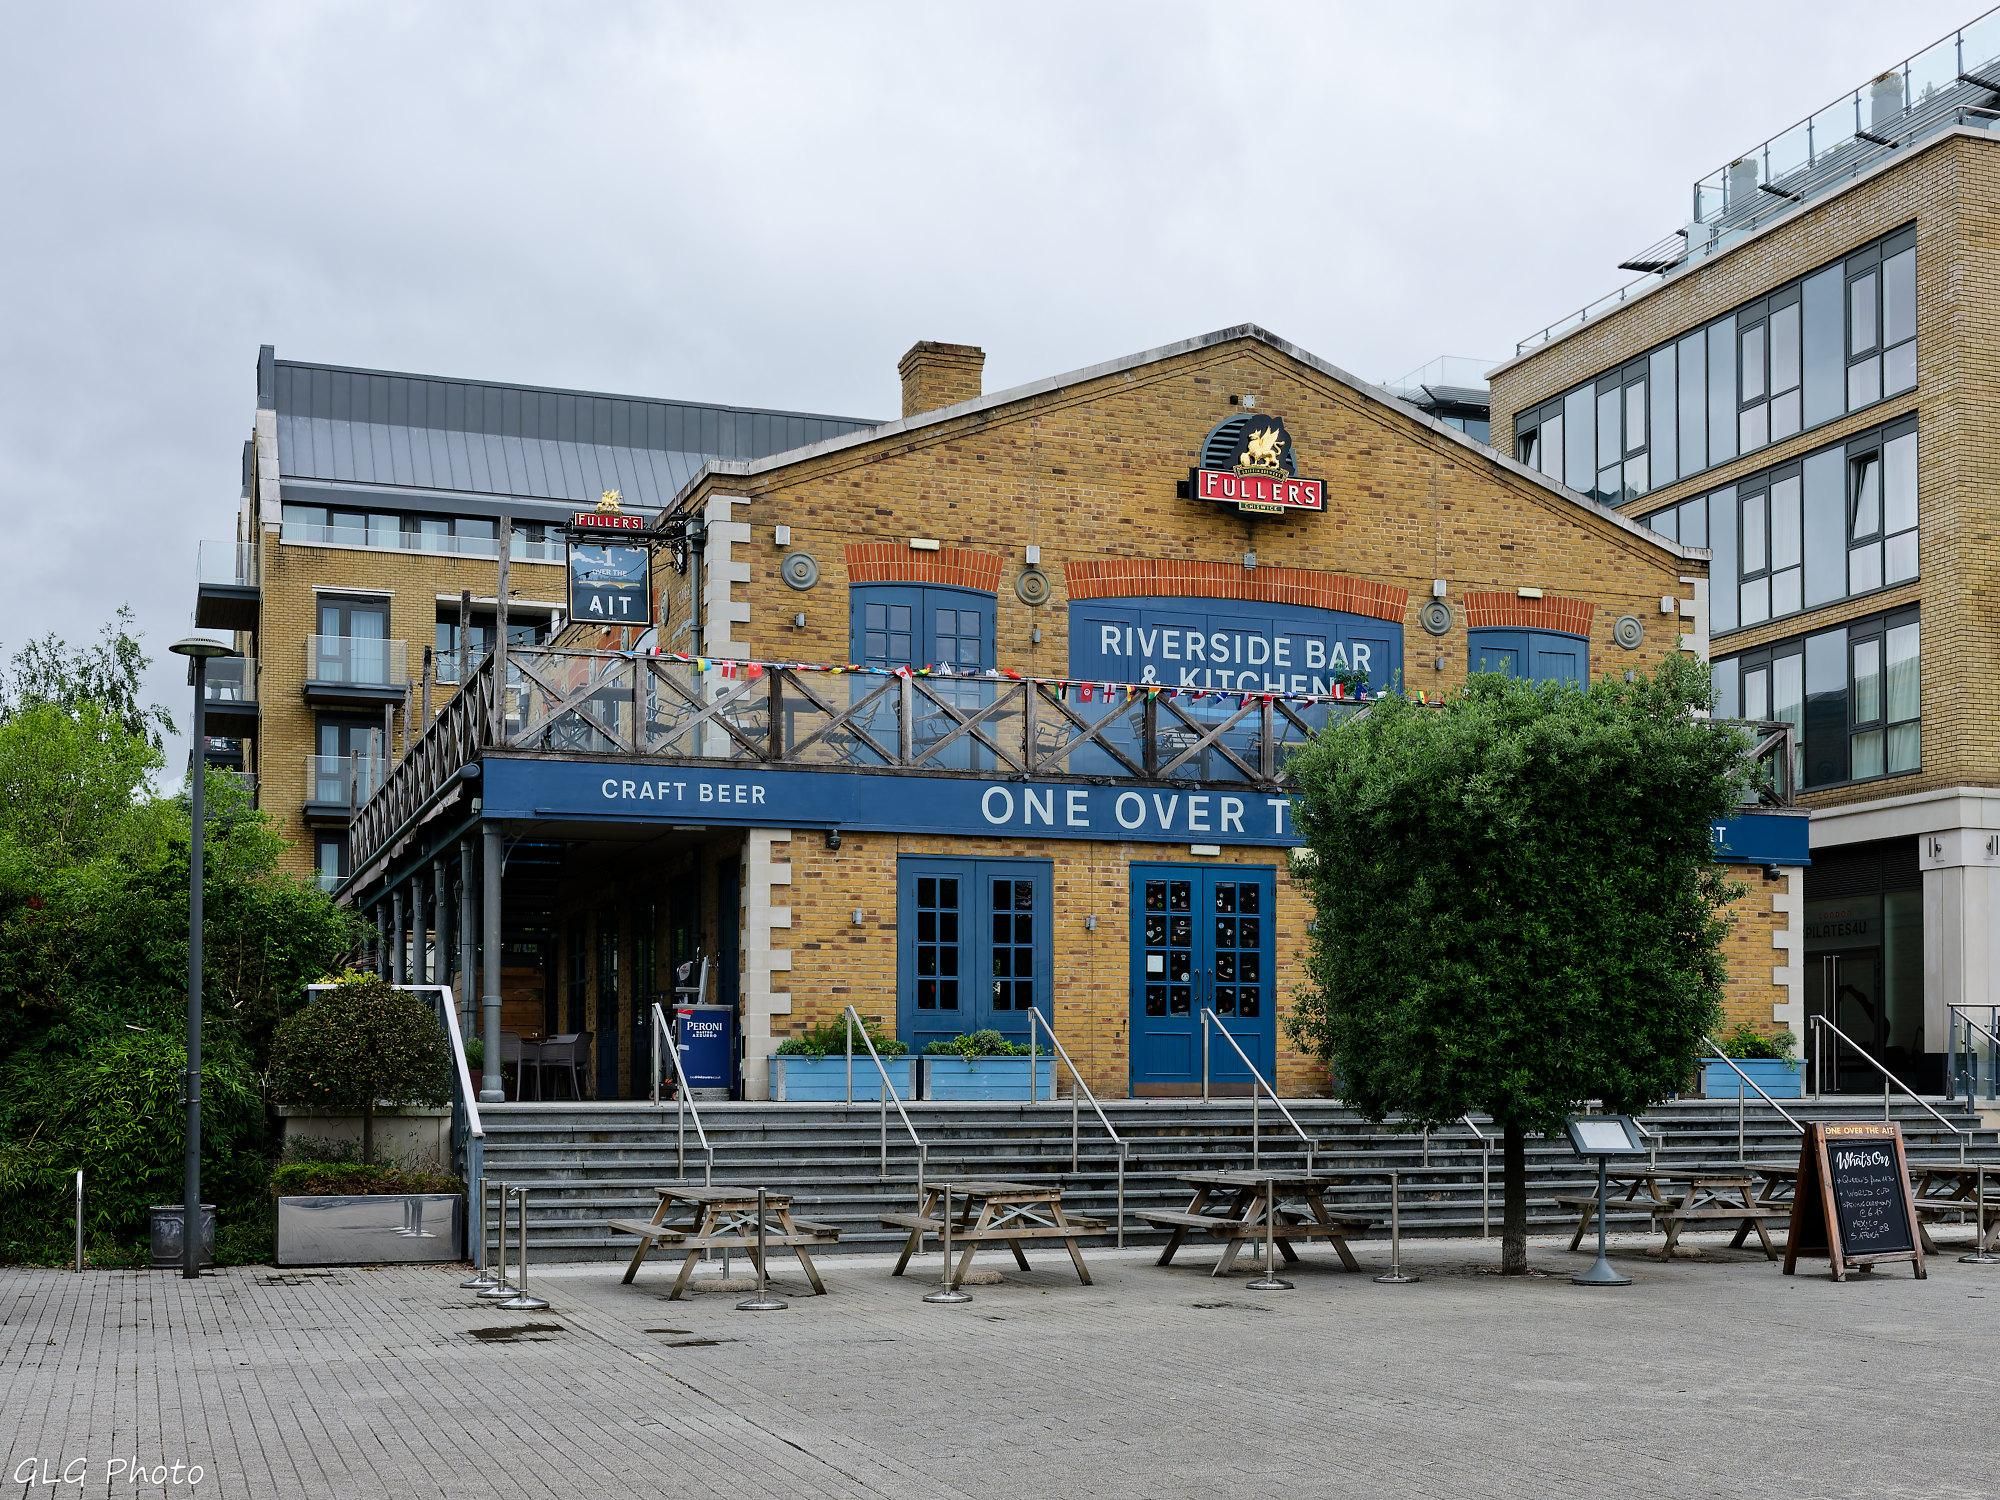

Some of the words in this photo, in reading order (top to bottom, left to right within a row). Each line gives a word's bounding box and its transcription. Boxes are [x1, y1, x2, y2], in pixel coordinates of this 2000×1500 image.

[1206, 473, 1316, 505] FULLER'S
[578, 513, 639, 530] FULLER'S
[601, 548, 616, 567] 1
[592, 568, 611, 576] OVER
[613, 569, 628, 577] THE
[588, 594, 632, 616] AIT
[1100, 625, 1293, 668] RIVERSIDE
[1306, 639, 1372, 672] BAR
[601, 778, 688, 801] CRAFT
[699, 783, 767, 805] BEER
[981, 785, 1090, 827] ONE
[1114, 791, 1245, 834] OVER
[1805, 921, 1867, 939] PILATES4U
[686, 1021, 723, 1031] PERONI
[1825, 1126, 1841, 1135] ONE
[1843, 1126, 1863, 1135] OVER
[1865, 1126, 1879, 1135] THE
[1881, 1126, 1894, 1136] AIT
[1836, 1151, 1872, 1170] What's
[1871, 1151, 1891, 1168] On
